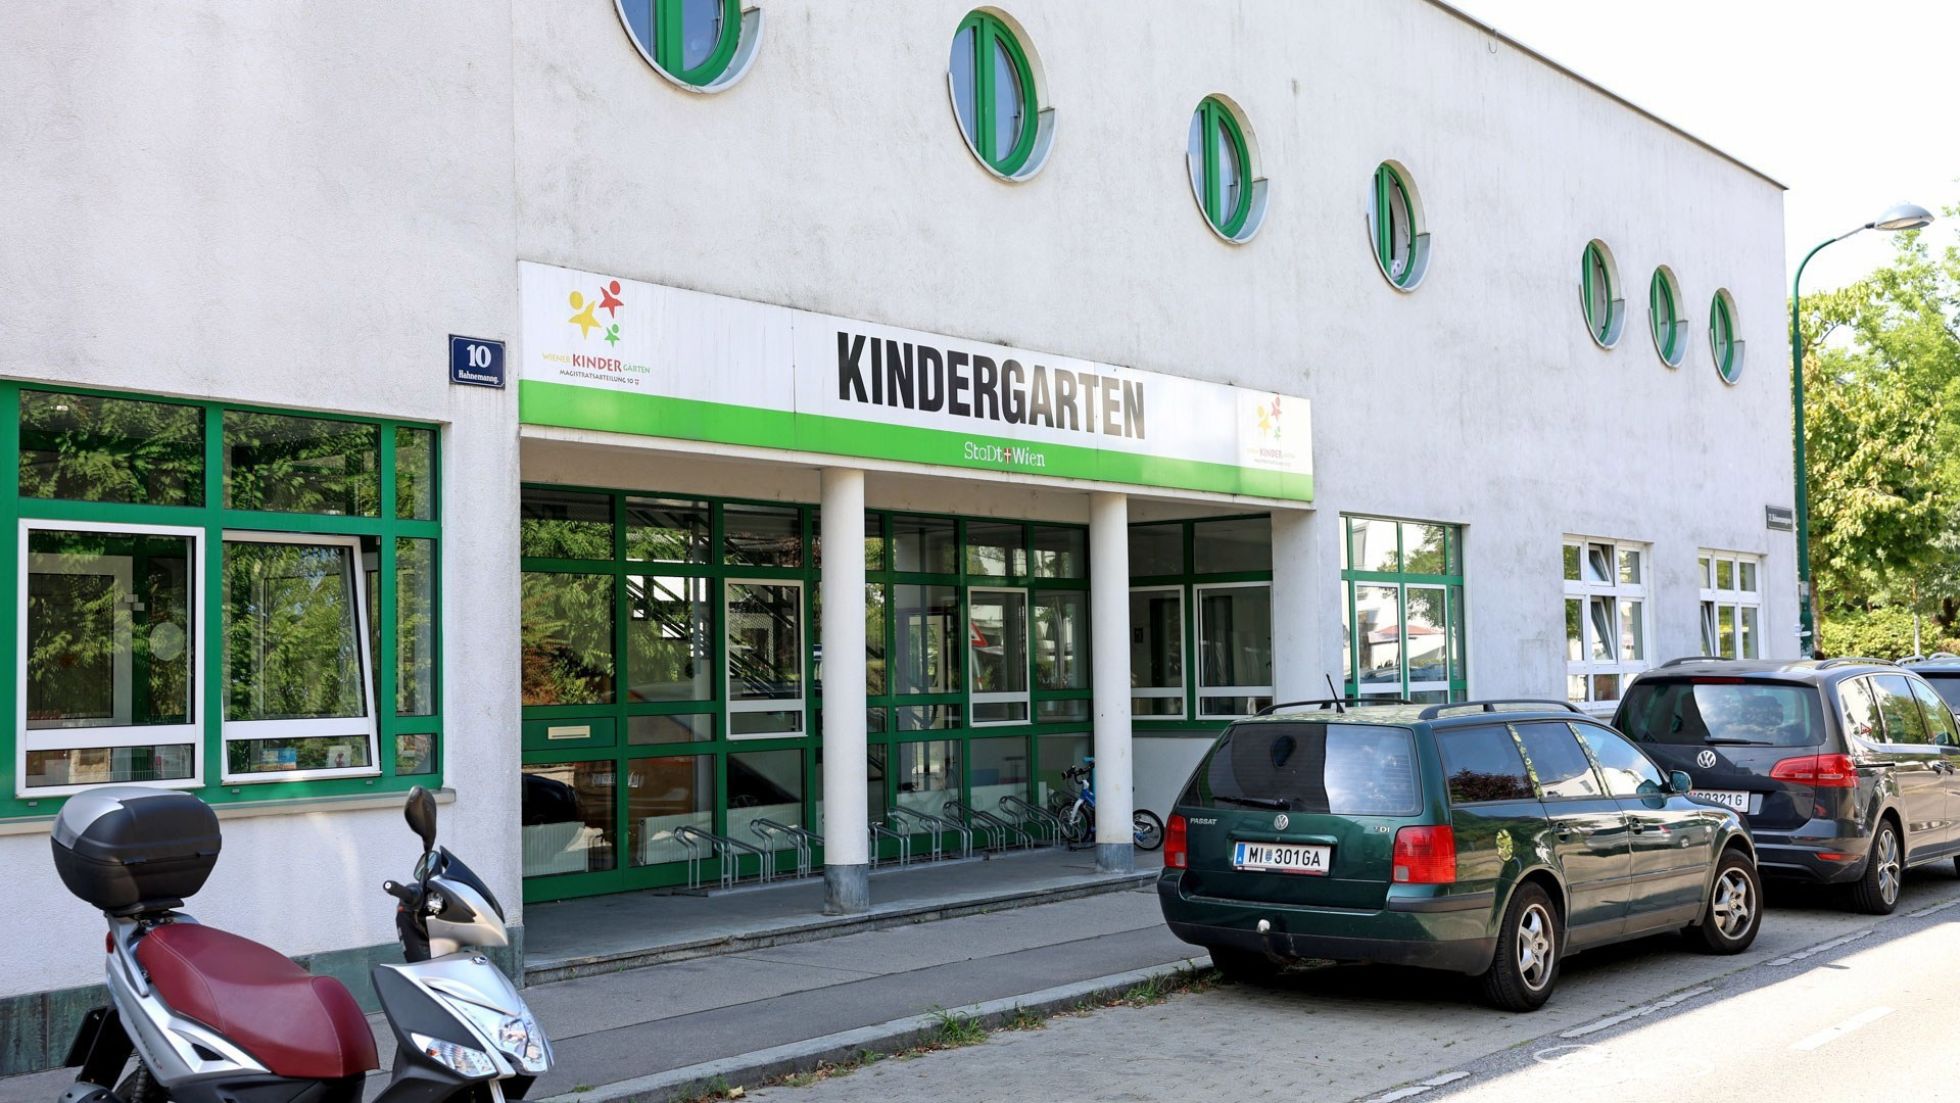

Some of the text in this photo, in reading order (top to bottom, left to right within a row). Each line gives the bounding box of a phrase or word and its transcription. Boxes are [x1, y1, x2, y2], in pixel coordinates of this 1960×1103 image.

[466, 344, 492, 368] 10
[542, 352, 571, 364] WIENER
[572, 353, 622, 373] KINDER
[559, 369, 626, 384] MAGISTRATSABTEILUNG
[837, 331, 1145, 440] KINDERGARTEN
[1012, 447, 1046, 467] Wien
[1190, 817, 1217, 825] PASSAT
[1248, 847, 1264, 863] MI
[1274, 849, 1321, 866] 301GA
